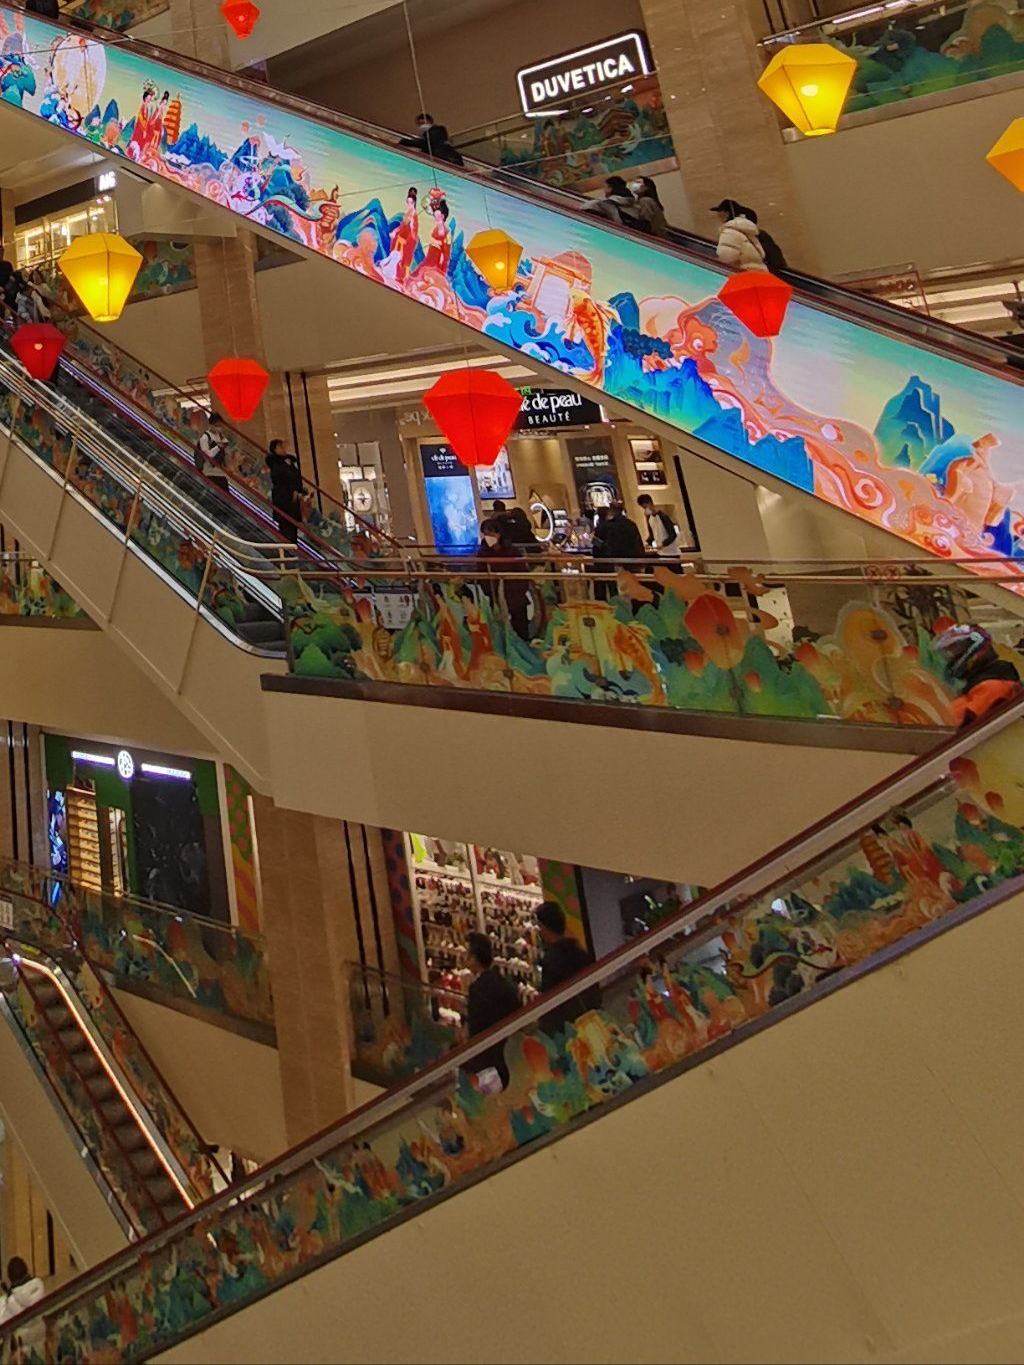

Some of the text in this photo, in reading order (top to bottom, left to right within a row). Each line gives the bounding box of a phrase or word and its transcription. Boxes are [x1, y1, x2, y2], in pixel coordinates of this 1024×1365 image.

[530, 54, 634, 102] DUVETICA
[532, 393, 549, 410] de
[550, 394, 582, 413] peau
[528, 411, 570, 424] BEAUTÉ
